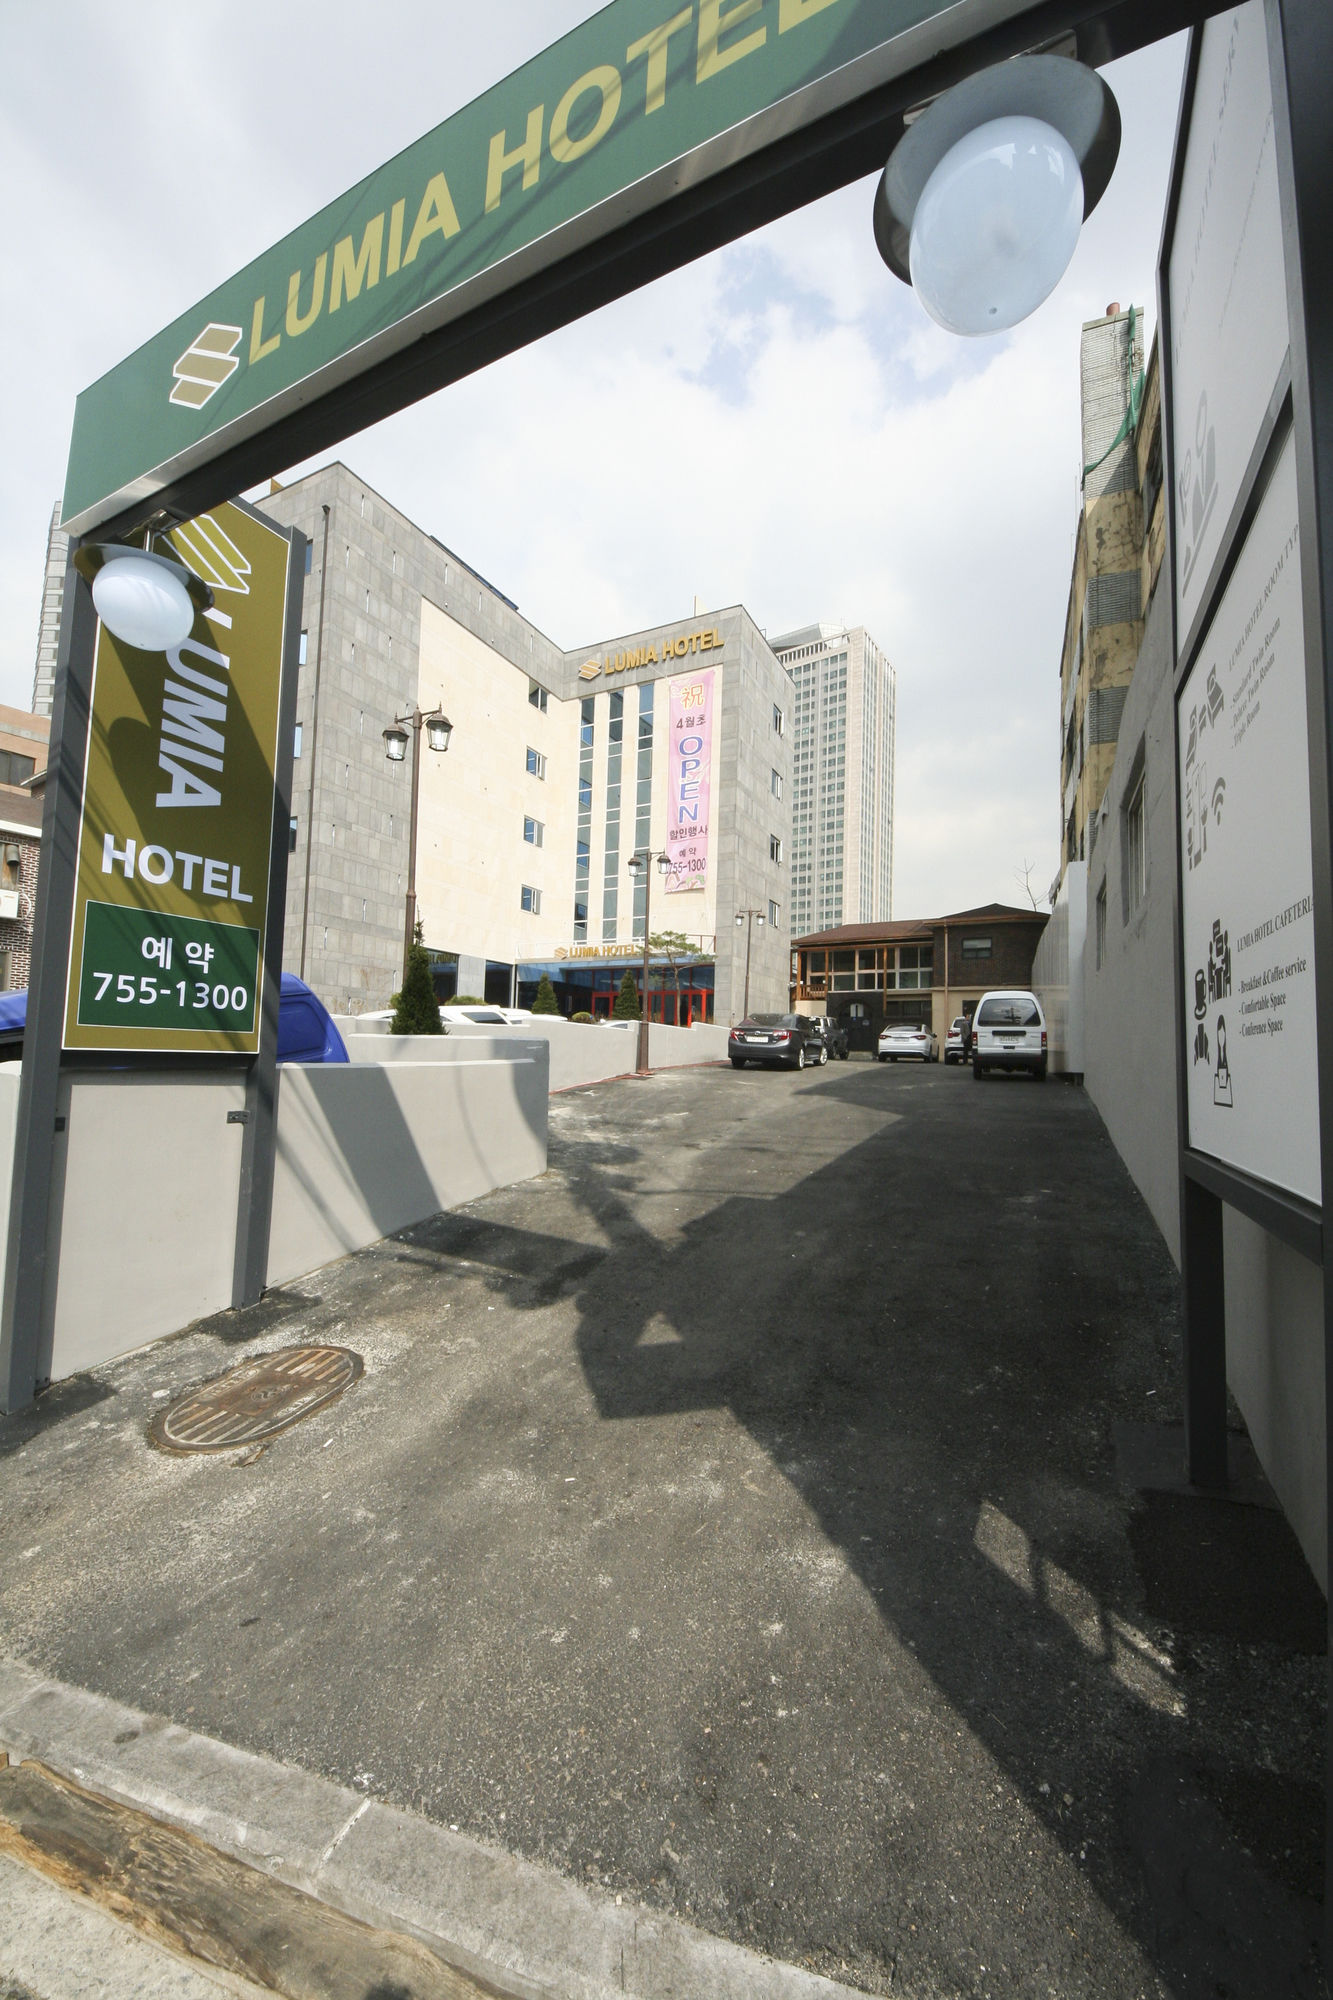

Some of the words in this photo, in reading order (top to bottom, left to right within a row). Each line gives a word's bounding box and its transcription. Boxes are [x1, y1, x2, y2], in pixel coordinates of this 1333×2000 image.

[248, 171, 461, 366] LUMIA
[1264, 617, 1280, 651] Room
[604, 645, 659, 675] LUMIA
[662, 627, 725, 661] HOTEL
[1260, 652, 1275, 684] Room
[682, 684, 704, 708] 祝
[1247, 700, 1260, 728] Room
[679, 736, 703, 824] OPEN
[101, 832, 254, 903] HOTEL
[1237, 931, 1254, 952] LUMIA
[1254, 919, 1275, 943] HOTEL
[1275, 895, 1313, 931] CAFETERI
[569, 946, 600, 958] LUMIA
[602, 944, 636, 957] HOTEL
[1285, 956, 1307, 978] service
[93, 972, 248, 1011] 755-1300
[1270, 992, 1286, 1011] Space
[1267, 1018, 1283, 1036] Space
